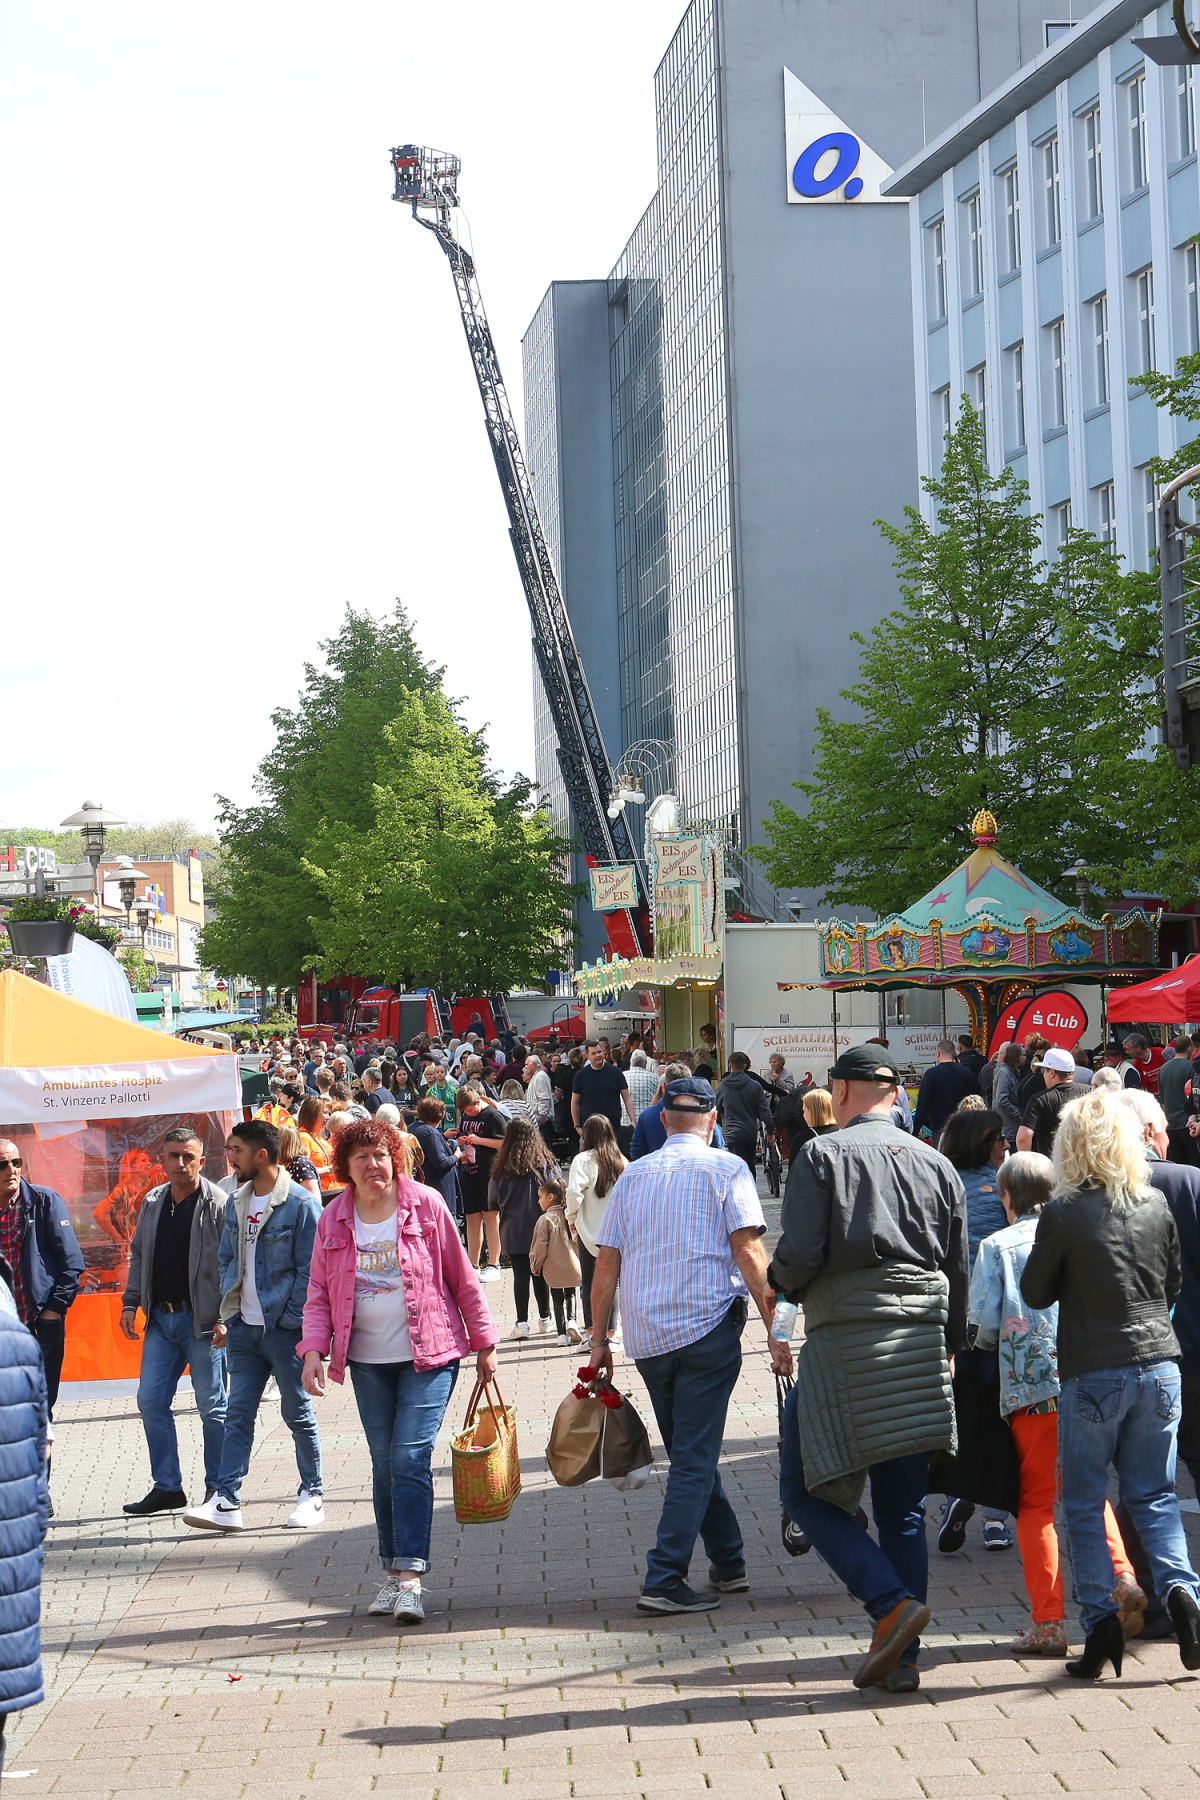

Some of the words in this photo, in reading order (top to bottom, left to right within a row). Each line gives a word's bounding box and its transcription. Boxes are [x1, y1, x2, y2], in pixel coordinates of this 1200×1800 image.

[662, 846, 681, 857] EIS
[661, 843, 698, 879] Schmalhaus
[598, 873, 615, 884] EIS
[679, 865, 697, 877] EIS
[599, 871, 630, 904] Schmalhaus
[613, 890, 630, 901] EIS
[1046, 1013, 1079, 1029] Club
[763, 1033, 851, 1047] SCHMALHAUS
[42, 1079, 118, 1092] Ambulantes
[121, 1075, 163, 1089] Hospiz
[43, 1097, 58, 1108] St.
[61, 1095, 107, 1107] Vinzenz
[110, 1091, 151, 1104] Pallotti
